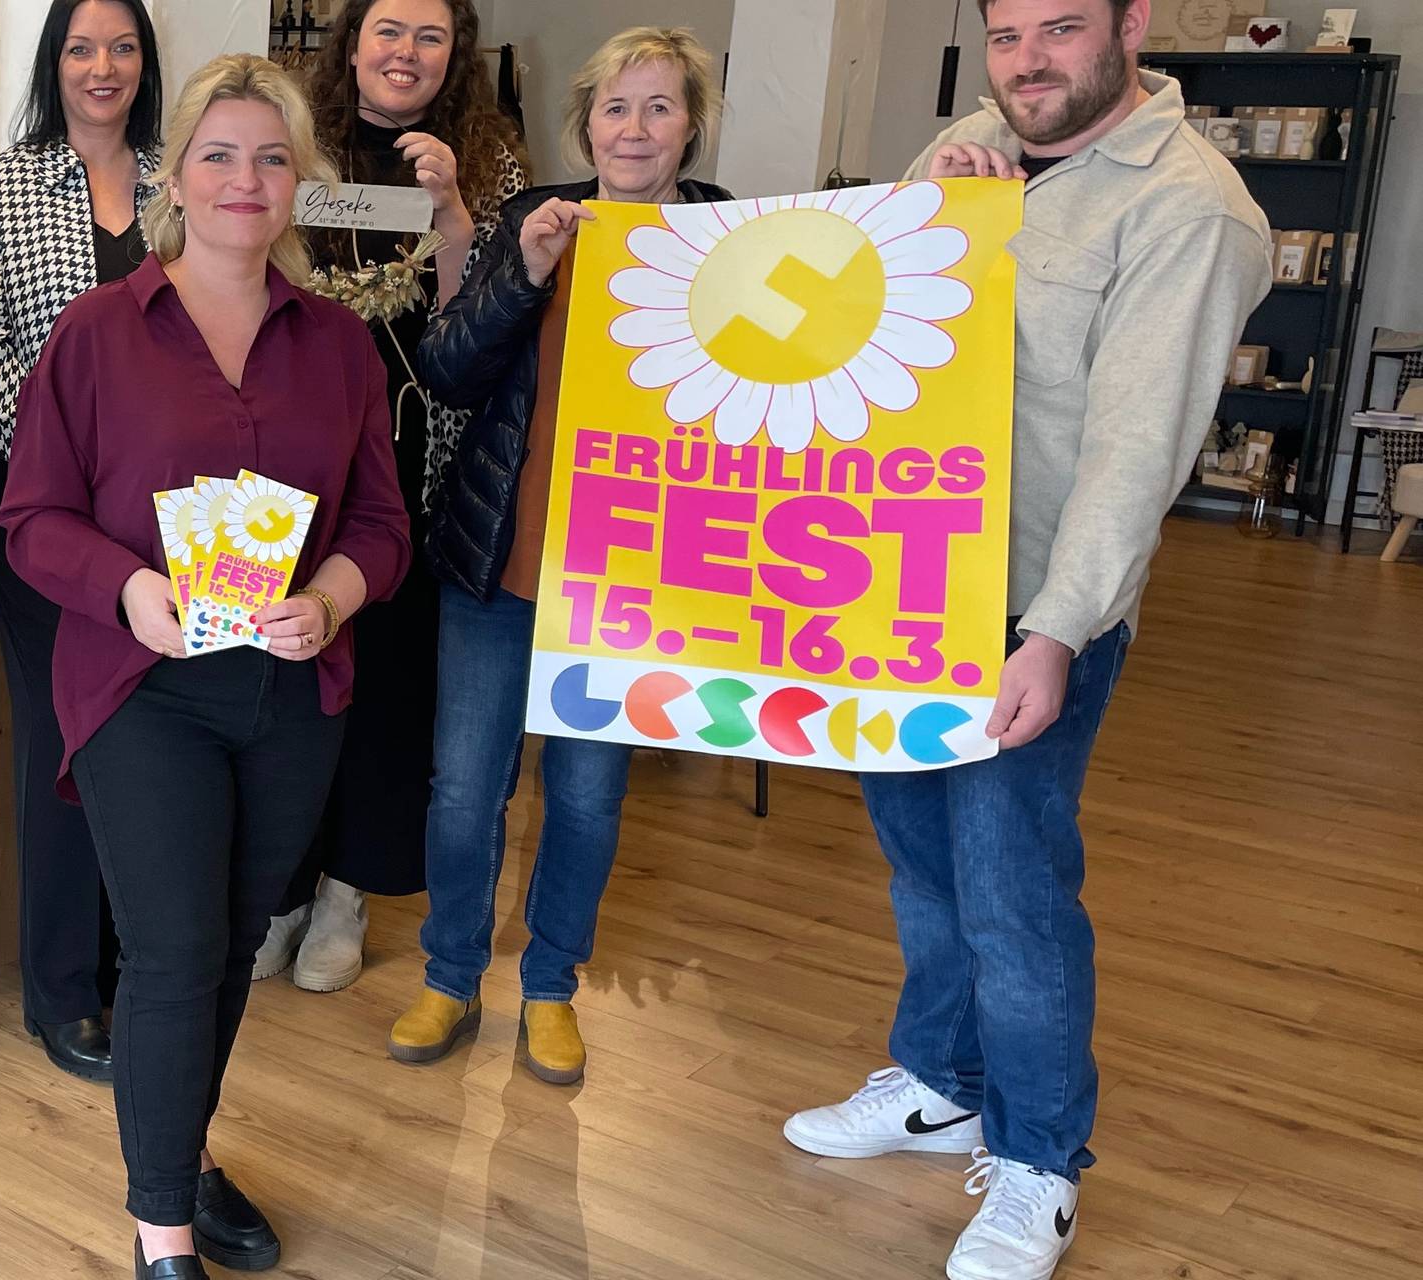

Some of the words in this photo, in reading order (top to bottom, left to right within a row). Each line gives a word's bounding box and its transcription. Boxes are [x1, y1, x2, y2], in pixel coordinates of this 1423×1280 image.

[302, 185, 376, 224] Geseke
[563, 471, 984, 614] FEST
[211, 561, 284, 599] FEST
